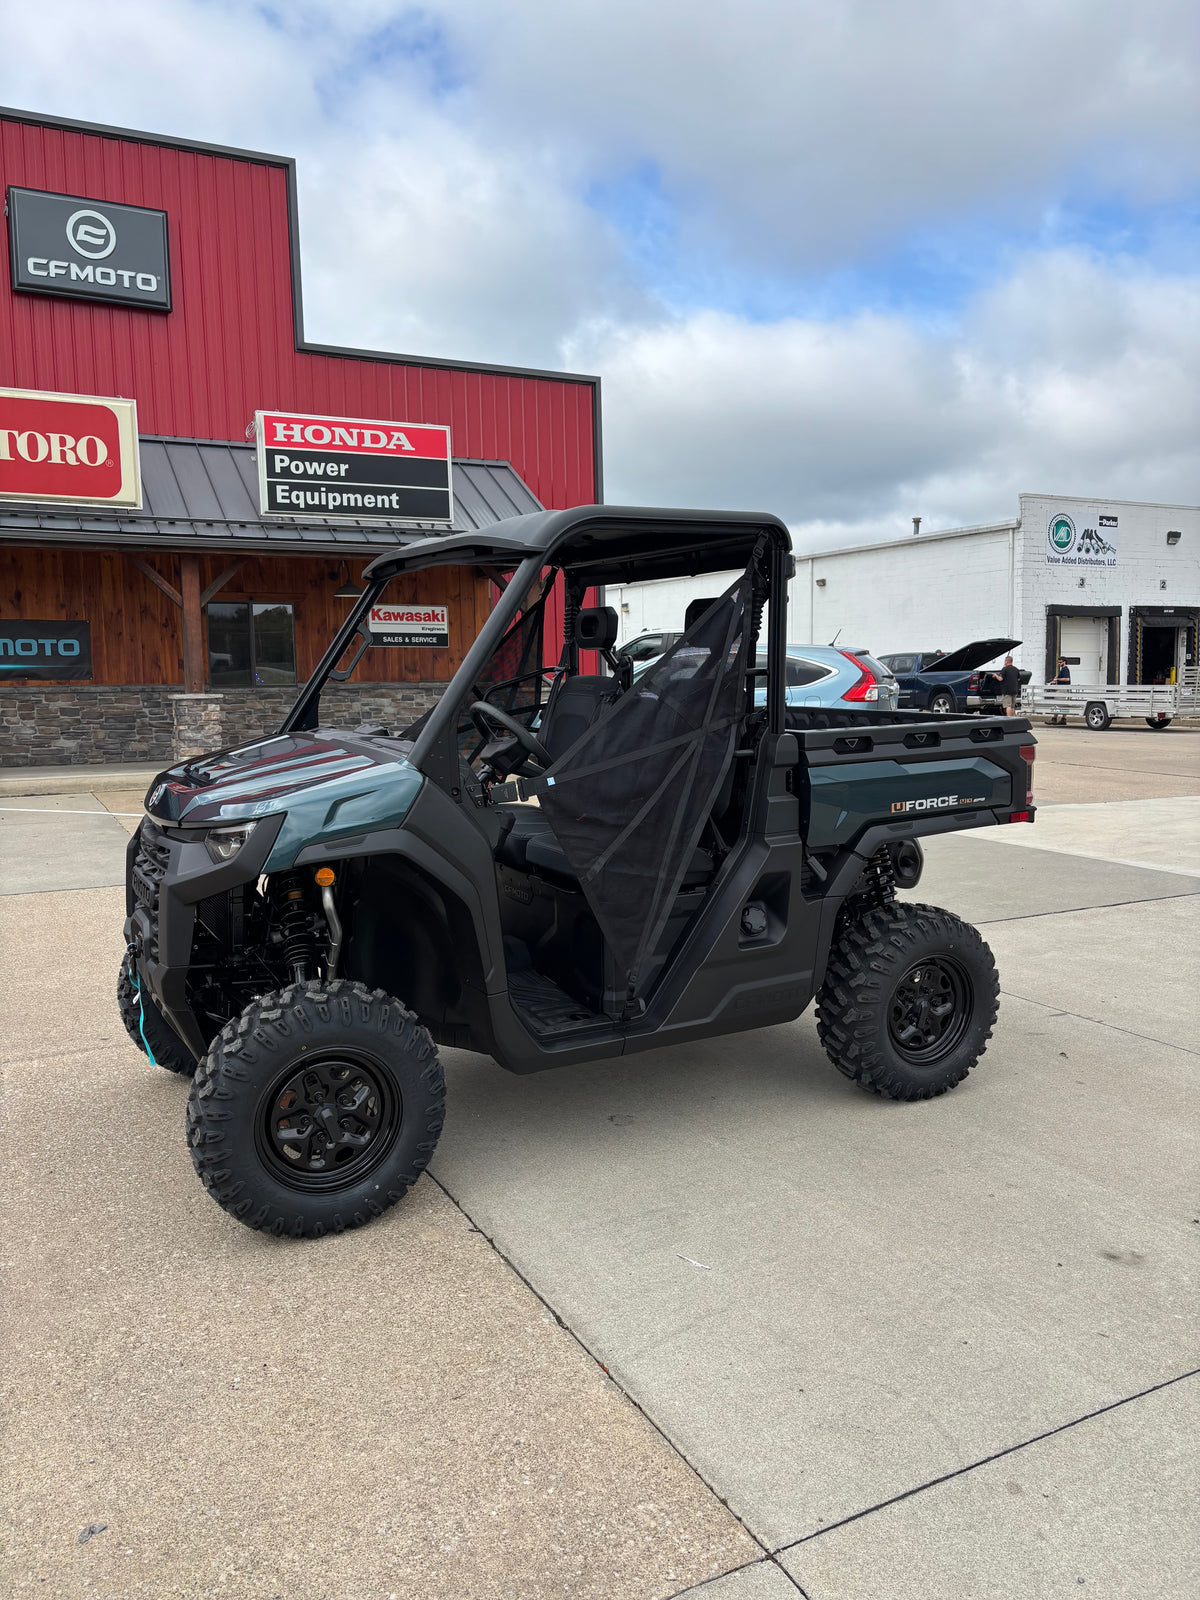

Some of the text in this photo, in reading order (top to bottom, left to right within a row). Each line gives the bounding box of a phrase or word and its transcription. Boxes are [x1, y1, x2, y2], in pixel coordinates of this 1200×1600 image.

[27, 257, 158, 292] CFMOTO
[0, 429, 108, 467] TORO
[272, 422, 415, 451] HONDA
[274, 455, 349, 477] Power
[276, 485, 400, 510] Equipment
[1047, 555, 1060, 564] Value
[1061, 556, 1077, 565] Added
[1107, 558, 1117, 567] LLC
[371, 608, 445, 623] Kawasaki
[411, 636, 438, 644] SERVICE
